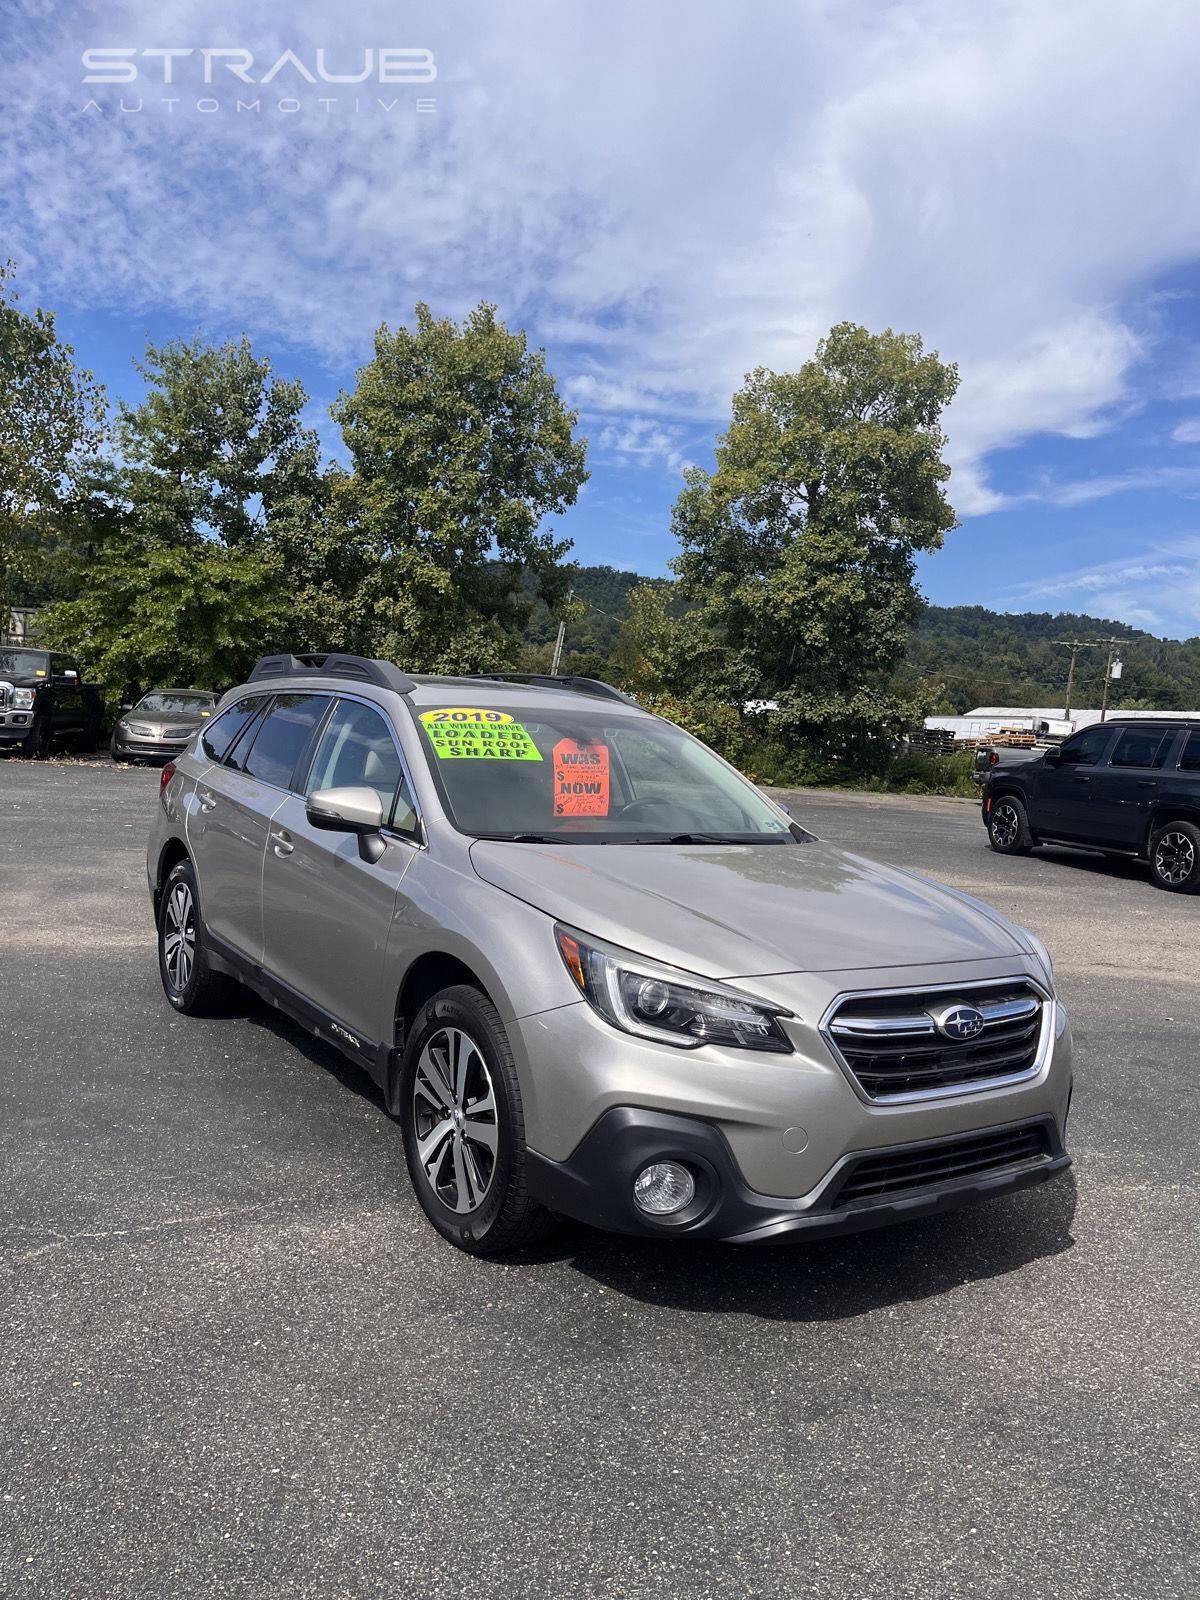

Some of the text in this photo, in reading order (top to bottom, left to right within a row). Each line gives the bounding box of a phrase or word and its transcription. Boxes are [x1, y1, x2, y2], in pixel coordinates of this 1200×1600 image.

[433, 712, 501, 722] 2019
[433, 730, 524, 741] LOADED
[435, 739, 532, 749] SUN ROOF
[450, 747, 528, 758] SHARP
[560, 753, 601, 765] WAS
[560, 782, 602, 794] NOW
